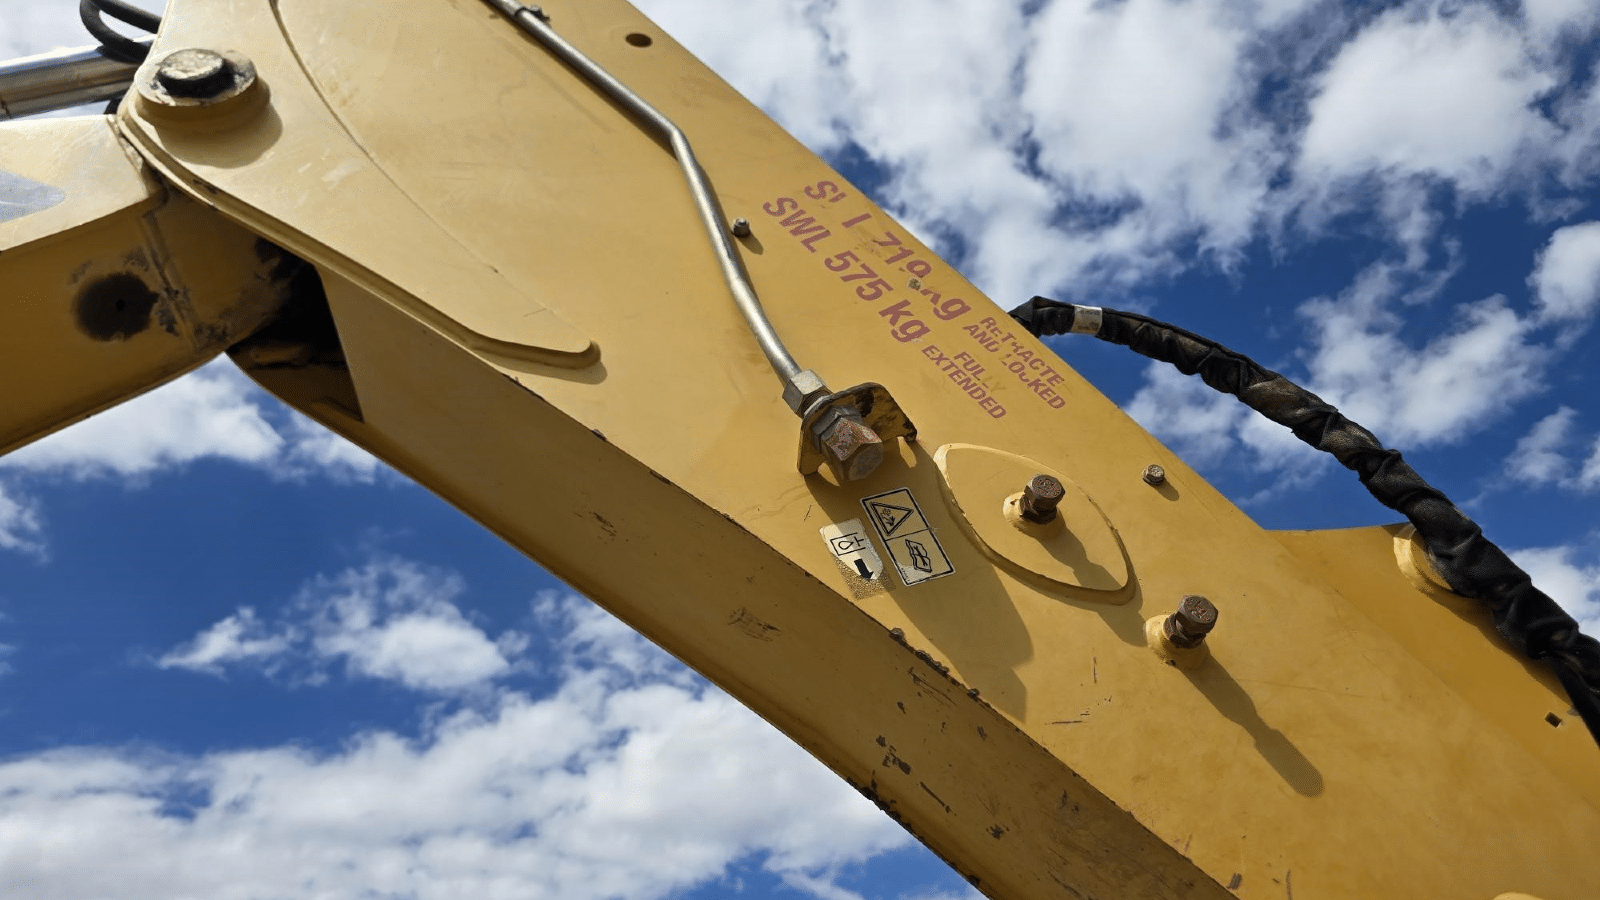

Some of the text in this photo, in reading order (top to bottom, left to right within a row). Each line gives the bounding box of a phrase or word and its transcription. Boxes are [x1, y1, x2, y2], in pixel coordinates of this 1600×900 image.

[763, 197, 932, 343] SWL 575 kg
[962, 324, 1000, 353] AND
[921, 344, 1007, 419] EXTENDED
